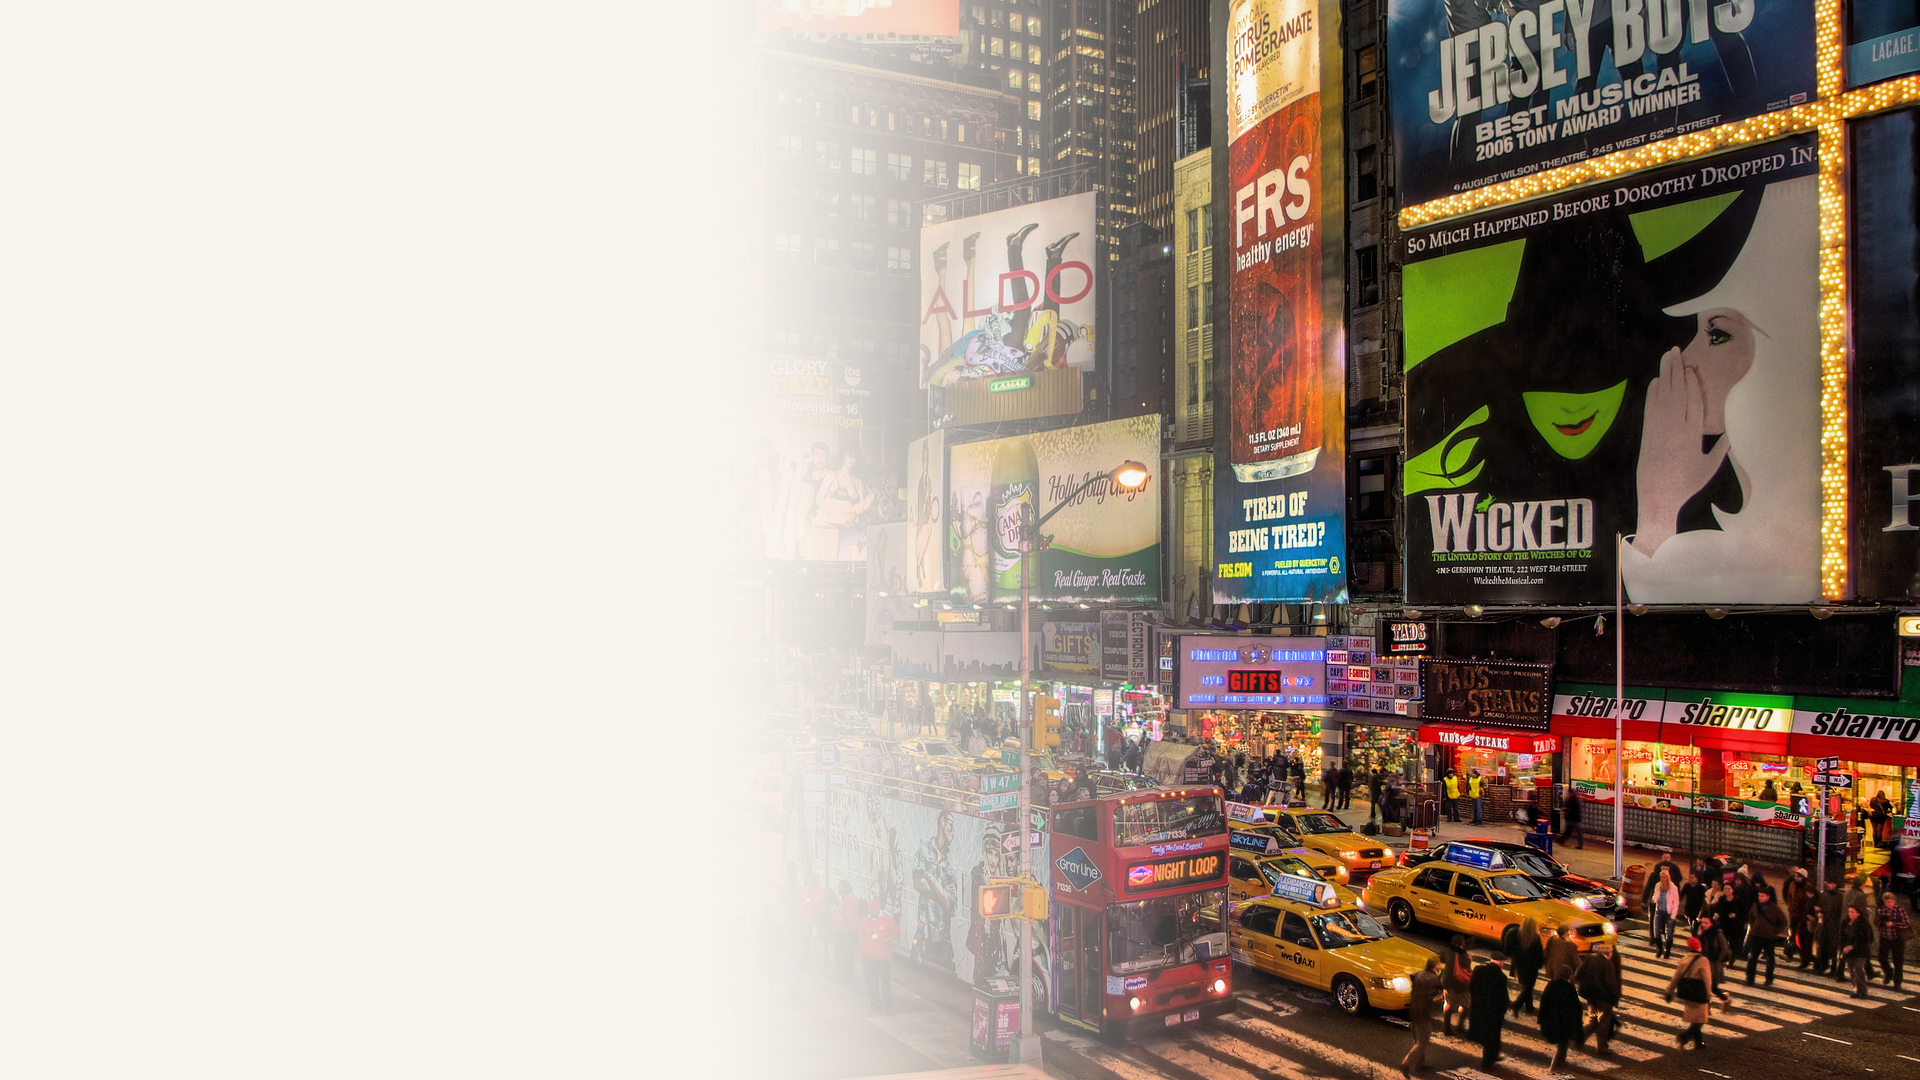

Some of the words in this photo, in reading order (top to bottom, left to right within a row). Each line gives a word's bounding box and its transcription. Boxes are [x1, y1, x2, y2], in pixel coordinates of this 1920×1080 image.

[1234, 13, 1270, 60] CITRUS
[1234, 10, 1313, 82] POMEGRANATE
[1428, 0, 1593, 124] JERSEY
[1611, 0, 1756, 68] BOYS
[1475, 104, 1548, 144] BEST
[1555, 62, 1700, 120] MUSICAL
[1476, 134, 1515, 163] 2006
[1515, 121, 1559, 151] TONY
[1627, 82, 1702, 118] WINNER
[1461, 174, 1500, 191] AUGUST
[1501, 161, 1540, 183] WILSON
[1541, 150, 1590, 171] THEATRE,
[1592, 145, 1613, 157] 245
[1615, 134, 1647, 150] WEST
[1677, 115, 1722, 134] STREET
[1236, 155, 1312, 249] FRS
[1236, 239, 1272, 274] healthy
[1275, 226, 1313, 255] energy
[921, 261, 1094, 326] ALDO
[769, 358, 829, 376] GLORY
[845, 365, 861, 377] tbs
[770, 375, 830, 398] DAZE
[836, 387, 850, 396] very
[851, 387, 872, 397] funny.
[994, 379, 1027, 391] LAMAR
[783, 401, 843, 414] november
[845, 403, 859, 416] 16
[778, 413, 832, 428] tuesdays
[833, 415, 864, 430] 10pm
[1248, 433, 1259, 444] 11.5
[1259, 431, 1268, 442] FL
[1268, 429, 1276, 441] OZ
[1253, 444, 1271, 455] DIETARY
[1271, 436, 1300, 452] SUPPLEMENT
[1048, 474, 1080, 508] Holly
[1076, 470, 1109, 506] Jolly
[907, 496, 940, 530] ALDO
[1242, 494, 1285, 522] TIRED
[1288, 491, 1308, 517] OF
[1228, 527, 1269, 553] BEING
[1271, 521, 1325, 550] TIRED?
[1218, 562, 1253, 578] FRS.COM
[1275, 560, 1292, 569] FUELED
[1292, 560, 1299, 568] BY
[1451, 566, 1484, 575] GERSHWIN
[1485, 565, 1516, 575] THEATRE,
[1517, 565, 1529, 573] 222
[1530, 565, 1549, 573] WEST
[1549, 564, 1562, 572] 51st
[1562, 564, 1588, 573] STREET
[1054, 570, 1073, 589] Real
[1073, 570, 1100, 592] Ginger.
[1101, 569, 1121, 587] Real
[1121, 568, 1147, 588] Taste.
[1474, 576, 1545, 586] WickedtheMusical.com
[1108, 630, 1126, 638] VIDEOS
[1391, 623, 1426, 641] TADS
[1052, 634, 1093, 655] GIFTS
[1349, 638, 1370, 648] T-SHIRTS
[1327, 652, 1347, 663] T-SHIRTS
[1230, 672, 1280, 692] GIFTS
[1330, 667, 1344, 678] CAPS
[1349, 668, 1370, 679] T-SHIRTS
[1396, 671, 1418, 682] T-SHIRTS
[1432, 663, 1490, 695] TAD'S
[1327, 682, 1347, 693] T-SHIRTS
[1352, 683, 1367, 694] CAPS
[1372, 684, 1394, 695] T-SHIRTS
[1349, 698, 1370, 709] T-SHIRTS
[1374, 700, 1390, 710] CAPS
[1468, 689, 1541, 718] STEAKS
[1484, 711, 1505, 719] CHICAGO
[1565, 690, 1648, 721] sbarro
[1680, 697, 1775, 730] sbarro
[1810, 707, 1920, 742] sbarro
[1438, 732, 1460, 744] TAD'S
[1474, 735, 1510, 750] STEAKS
[1533, 738, 1556, 754] TAD'S
[1585, 743, 1606, 756] Pizza
[1621, 747, 1654, 761] esserts
[989, 777, 997, 790] W
[998, 775, 1011, 789] 47
[1012, 774, 1019, 782] ST
[1575, 785, 1596, 795] sbarro
[980, 796, 1000, 808] FATHER
[1000, 793, 1018, 805] DUFFY
[1655, 789, 1687, 801] EATERY
[1774, 810, 1800, 821] sbarro
[1006, 837, 1018, 848] ONE
[1167, 829, 1187, 840] 71336
[1230, 834, 1268, 848] SKYLINE
[1154, 860, 1187, 882] NIGHT
[1188, 855, 1218, 877] LOOP
[1056, 881, 1072, 894] 71336
[1281, 951, 1293, 962] NYC
